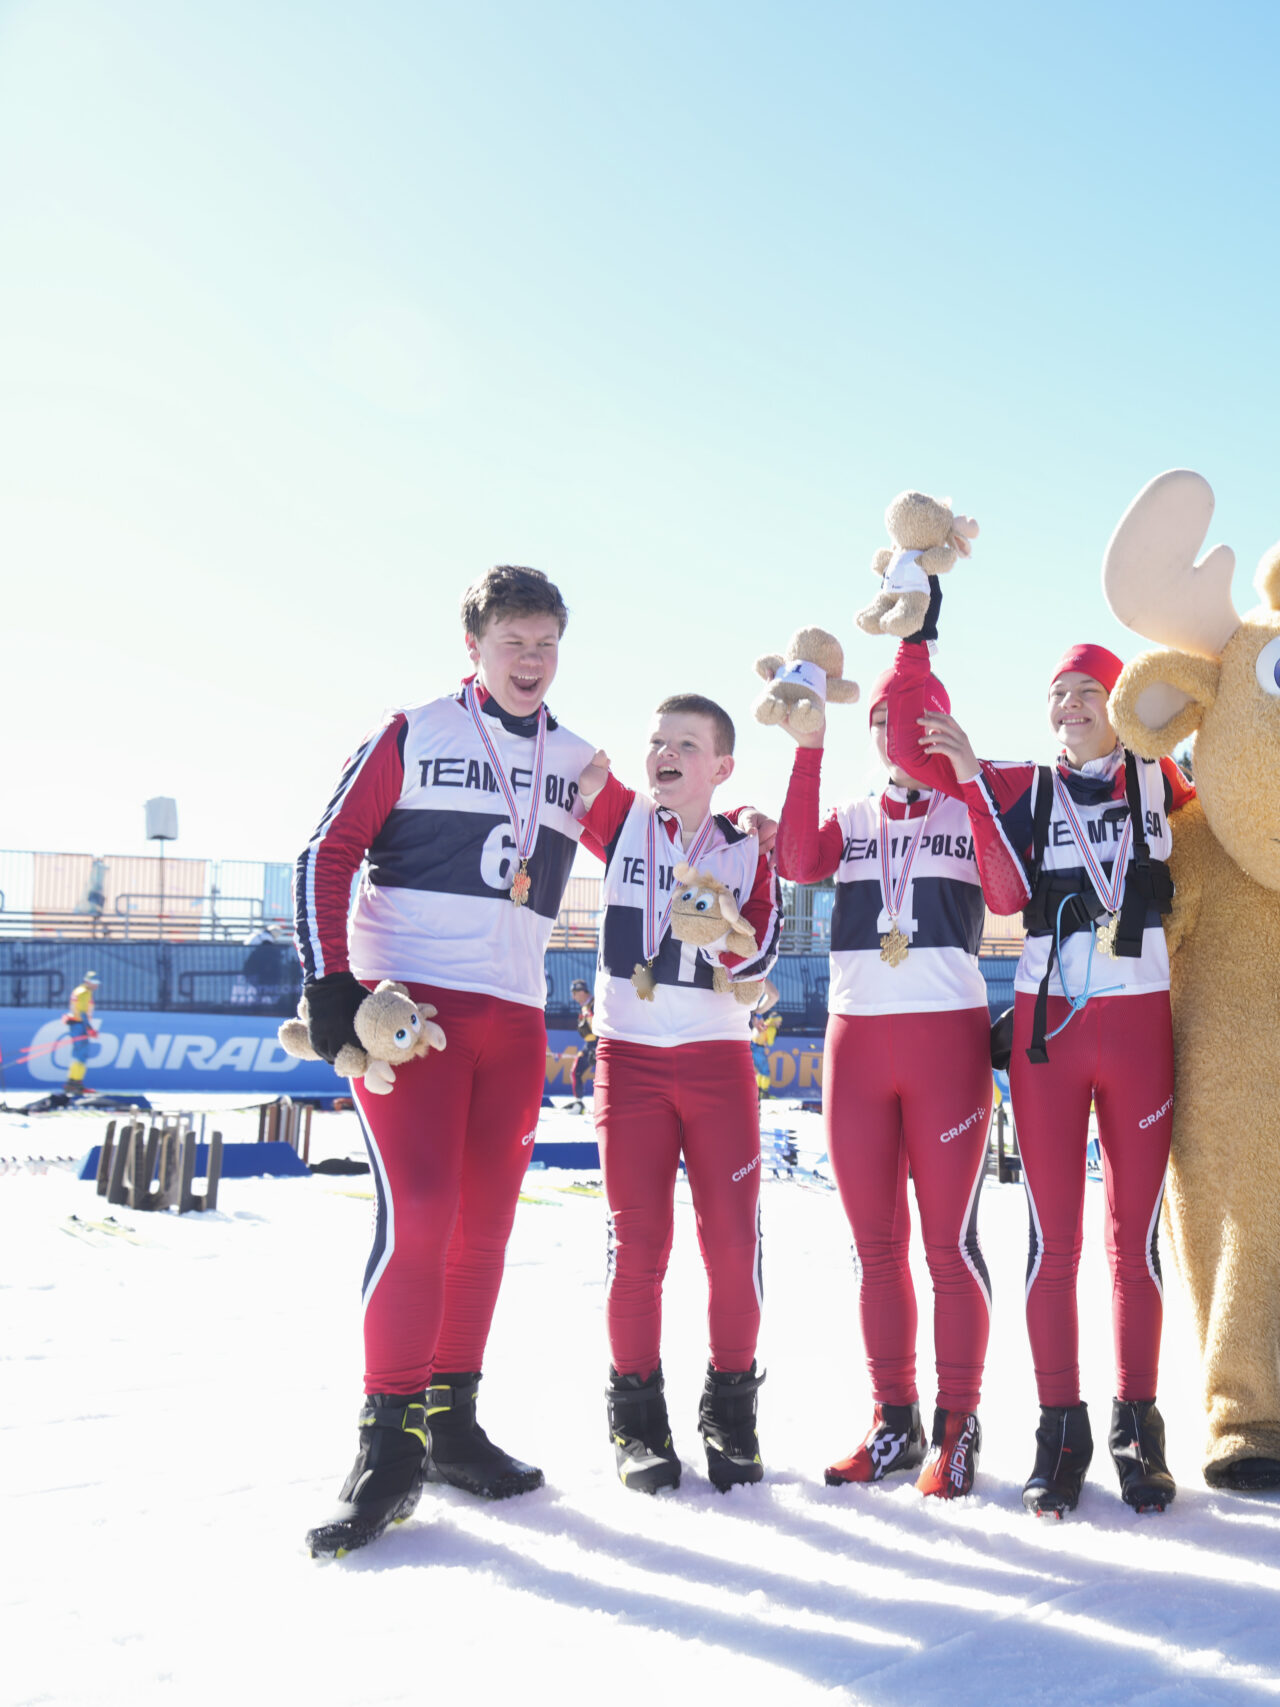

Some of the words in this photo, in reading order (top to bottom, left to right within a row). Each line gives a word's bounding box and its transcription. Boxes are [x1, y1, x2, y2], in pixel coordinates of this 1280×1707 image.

[480, 822, 522, 891] 6
[876, 880, 919, 944] 4
[26, 1018, 302, 1083] CONRAD
[939, 1112, 977, 1143] CRAFT
[1139, 1099, 1170, 1129] CRAFT
[731, 1153, 760, 1182] CRAFT
